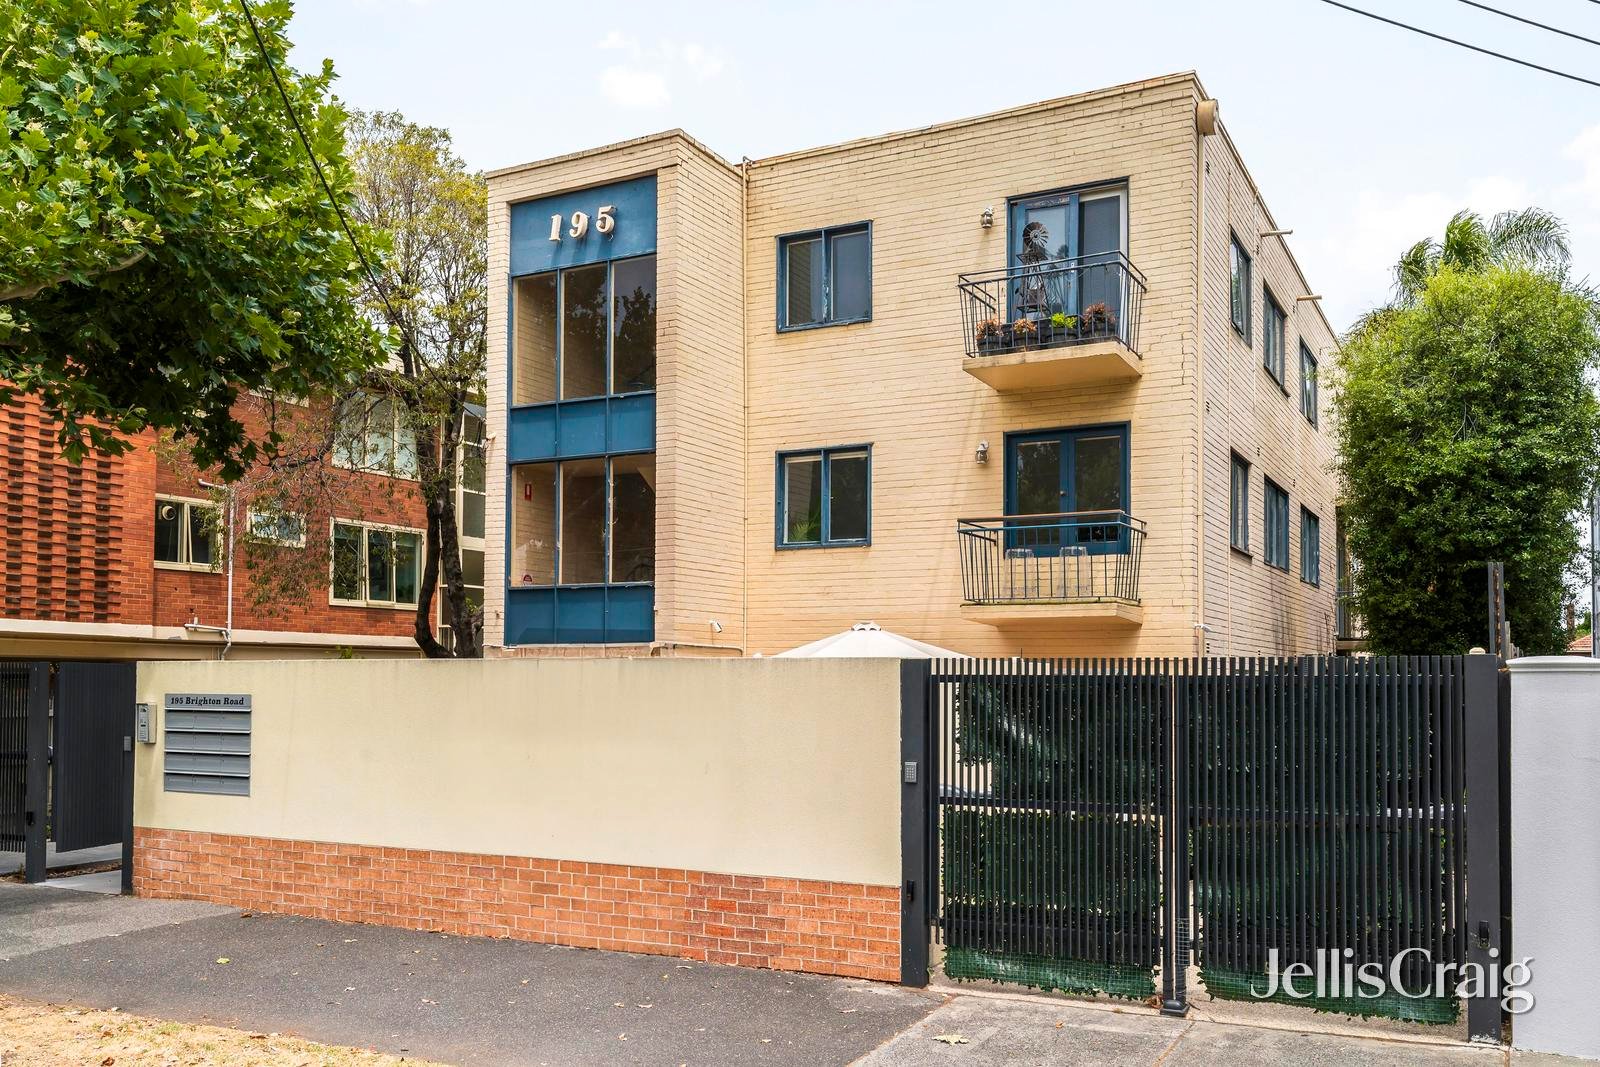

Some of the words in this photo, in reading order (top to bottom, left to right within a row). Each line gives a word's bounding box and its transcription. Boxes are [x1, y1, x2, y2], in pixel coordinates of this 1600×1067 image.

[548, 205, 617, 241] 195
[170, 697, 184, 705] 195
[185, 697, 221, 706] Brighton
[223, 697, 244, 706] Road
